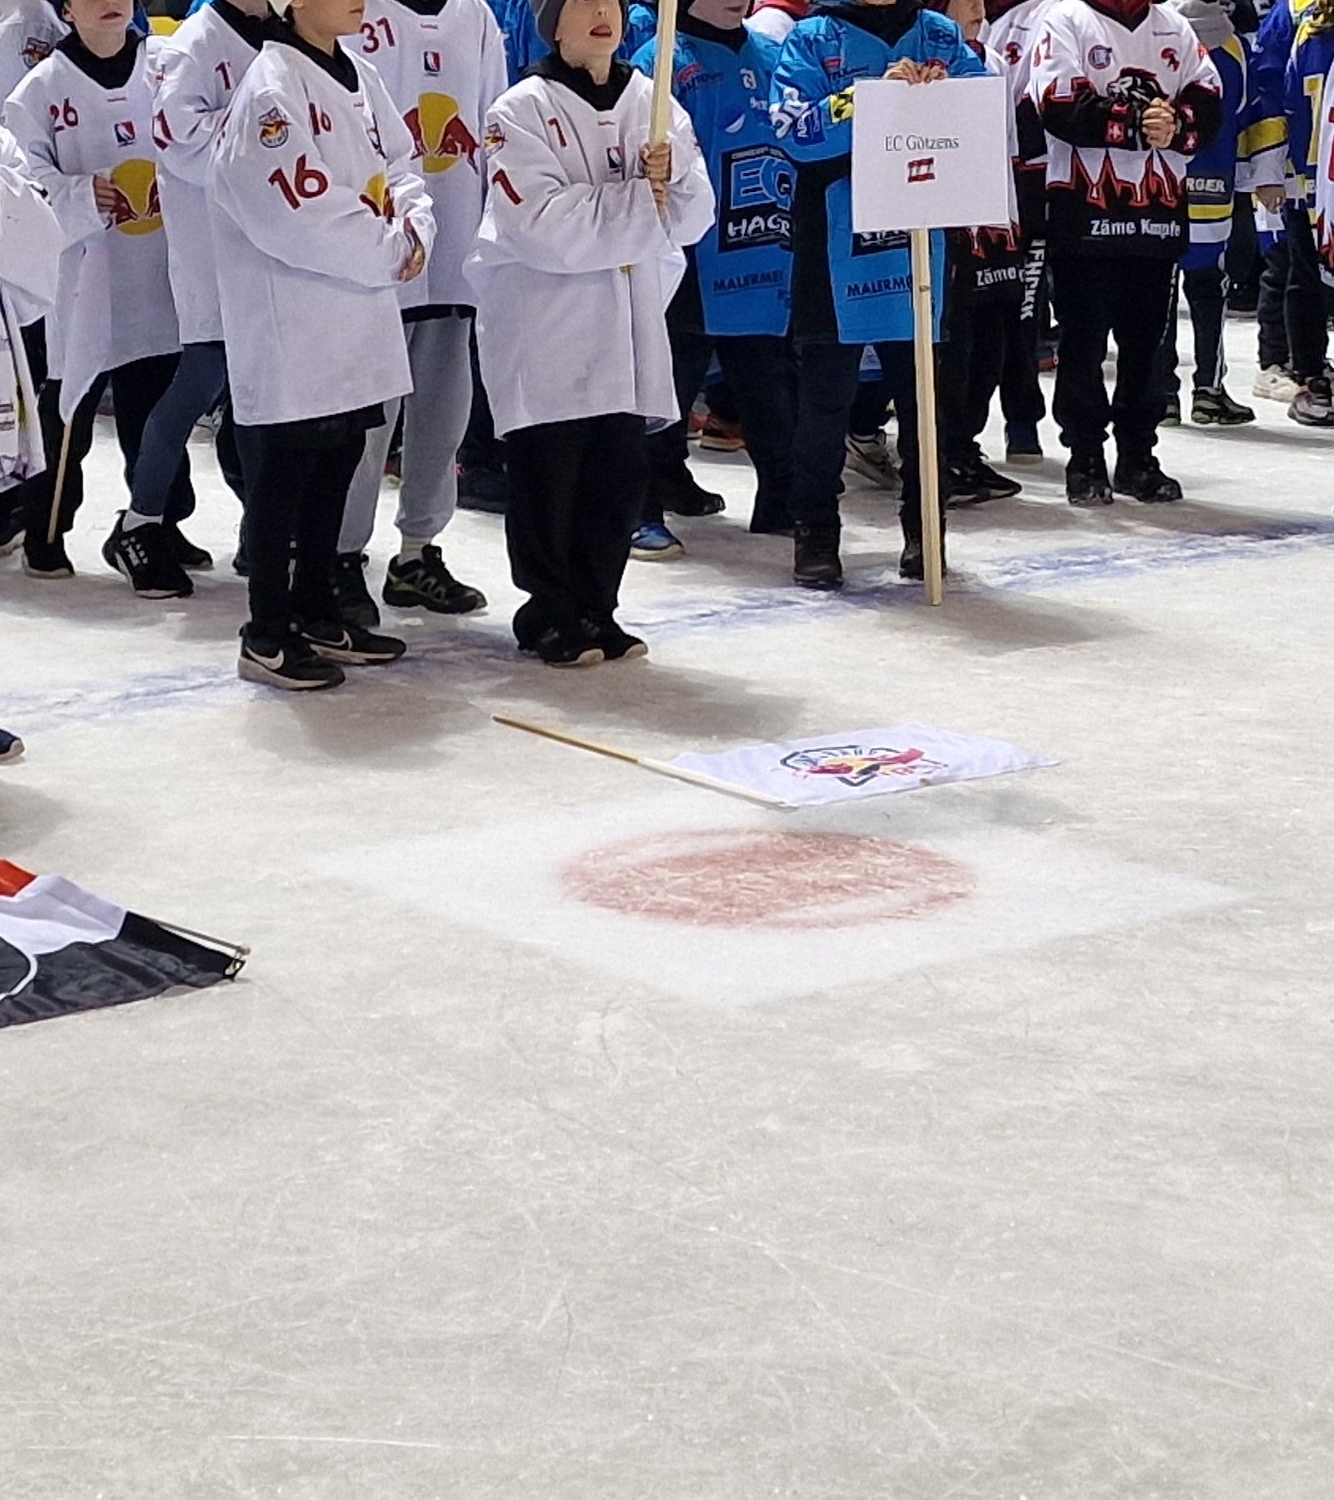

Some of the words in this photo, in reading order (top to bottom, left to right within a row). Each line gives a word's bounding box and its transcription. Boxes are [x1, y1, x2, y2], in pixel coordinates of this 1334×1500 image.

[361, 17, 396, 53] 31
[49, 97, 79, 132] 26
[885, 135, 903, 151] EC
[906, 134, 960, 151] Götzens
[267, 153, 330, 211] 16
